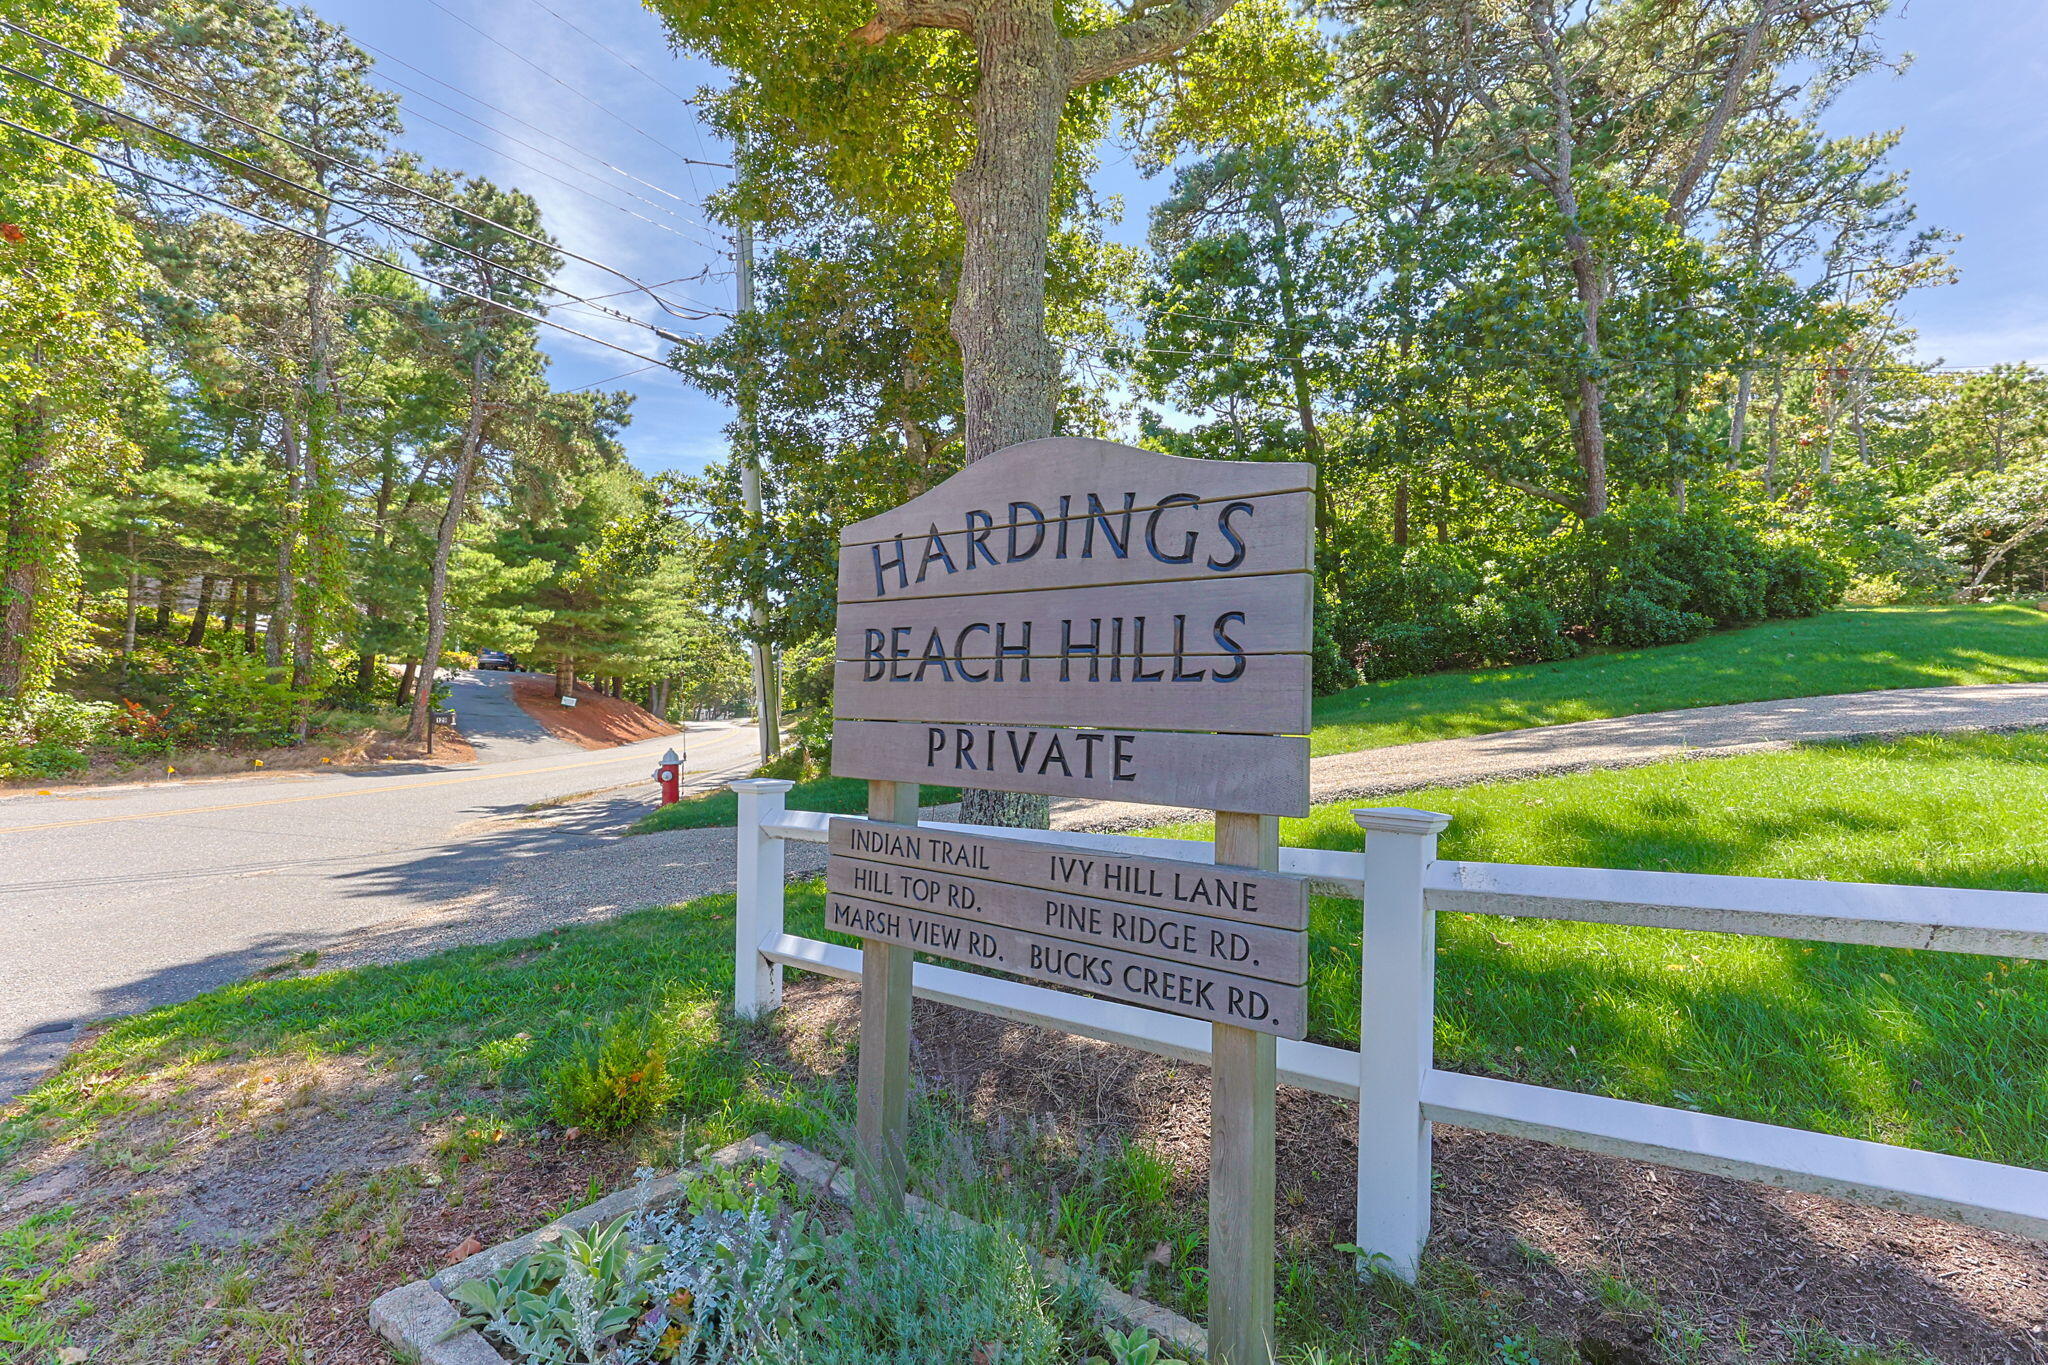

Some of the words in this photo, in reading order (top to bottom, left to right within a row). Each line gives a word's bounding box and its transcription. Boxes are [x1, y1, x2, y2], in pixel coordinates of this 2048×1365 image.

[872, 491, 1254, 597] HARDINGS
[863, 619, 1033, 683] BEACH
[1060, 611, 1247, 684] HILLS
[927, 727, 1137, 782] PRIVATE
[850, 828, 921, 861] INDIAN
[928, 839, 991, 871] TRAIL
[854, 867, 894, 896] HILL
[900, 876, 941, 902] TOP
[948, 884, 982, 912] RD.
[1050, 855, 1095, 882] IVY
[1104, 863, 1163, 898] HILL
[1174, 872, 1259, 912] LANE
[834, 902, 900, 938] MARSH
[907, 917, 962, 950] VIEW
[968, 931, 1005, 962] RD.
[1045, 900, 1102, 935] PINE
[1112, 911, 1197, 954] RIDGE
[1209, 930, 1261, 967] RD.
[1030, 944, 1114, 986] BUCKS
[1123, 965, 1216, 1011] CREEK
[1227, 986, 1281, 1026] RD.
